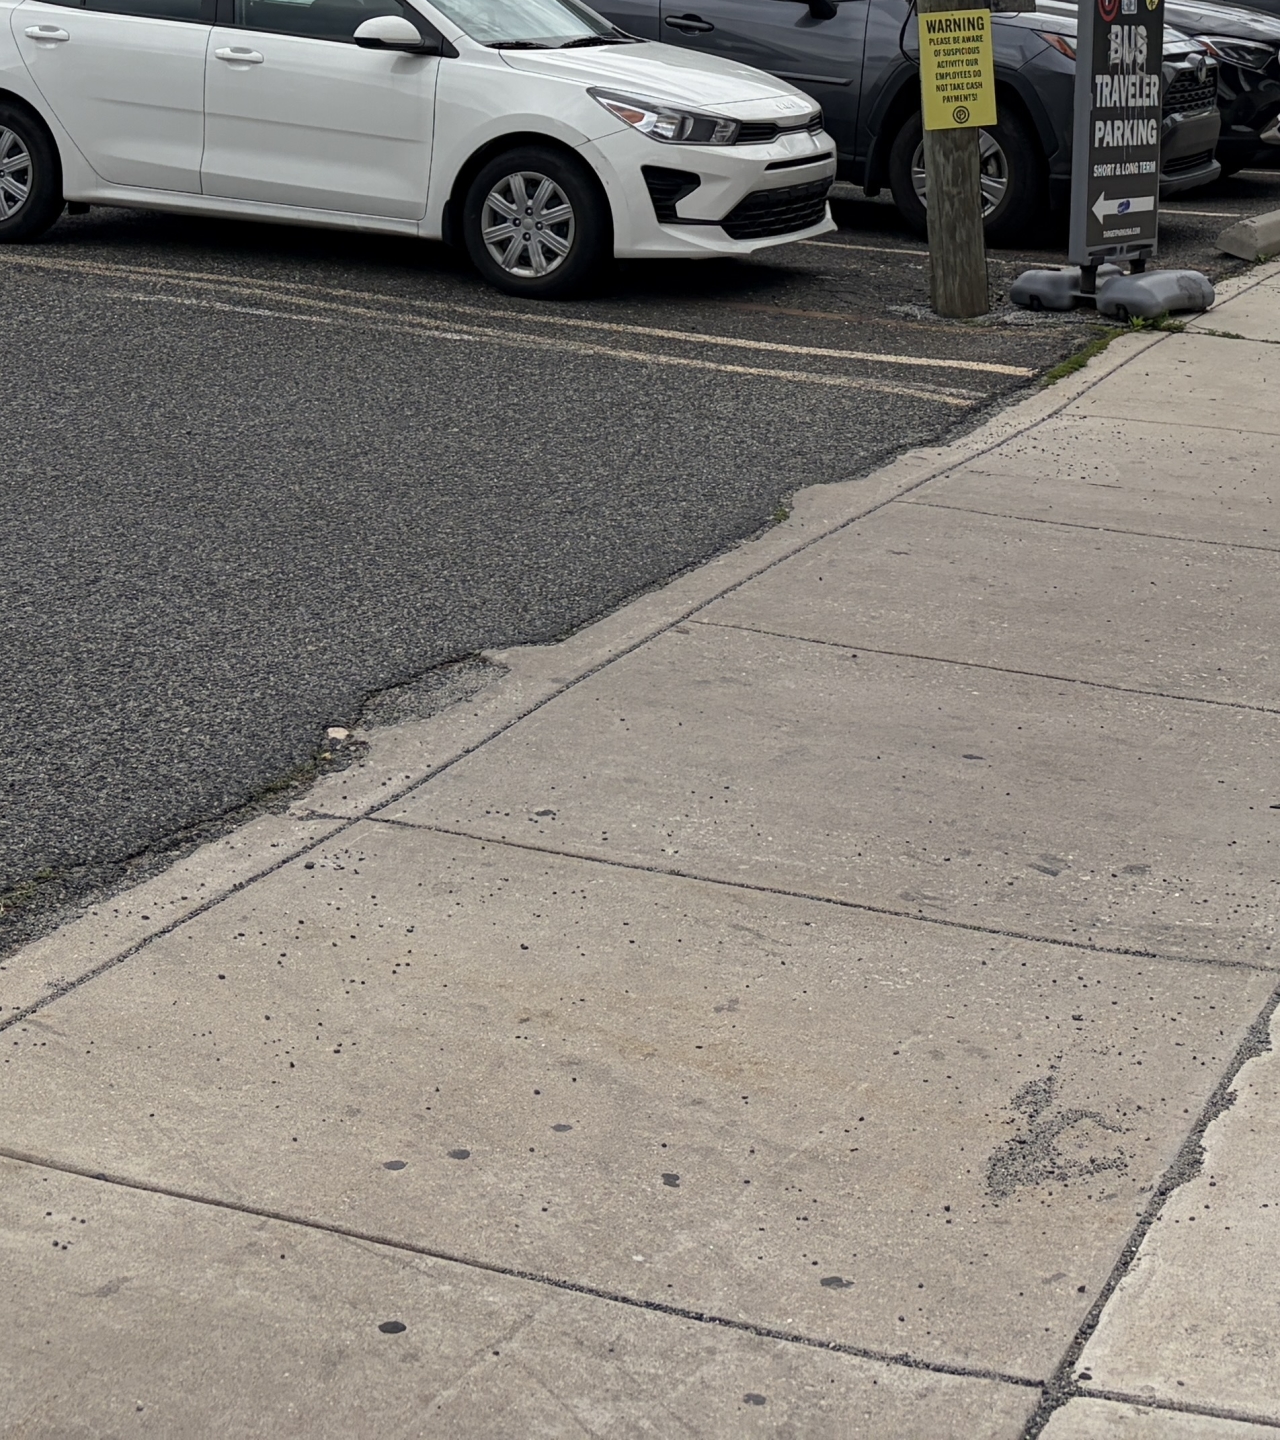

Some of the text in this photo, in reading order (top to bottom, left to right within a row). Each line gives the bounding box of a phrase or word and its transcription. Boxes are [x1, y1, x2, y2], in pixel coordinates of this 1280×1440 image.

[926, 16, 984, 34] WARNING
[929, 35, 983, 46] PLEASE BE AWARE
[934, 46, 980, 57] OF SUSPICIOUS
[937, 58, 978, 68] ACTIVITY OUR
[935, 70, 981, 80] EMPLOYEES DO
[936, 82, 982, 92] NOT TAKE CASH
[1095, 74, 1159, 107] TRAVELER
[943, 93, 978, 104] PAYMENTS!
[1095, 118, 1157, 148] PARKING
[1094, 161, 1155, 177] SHORT & LONG TERM
